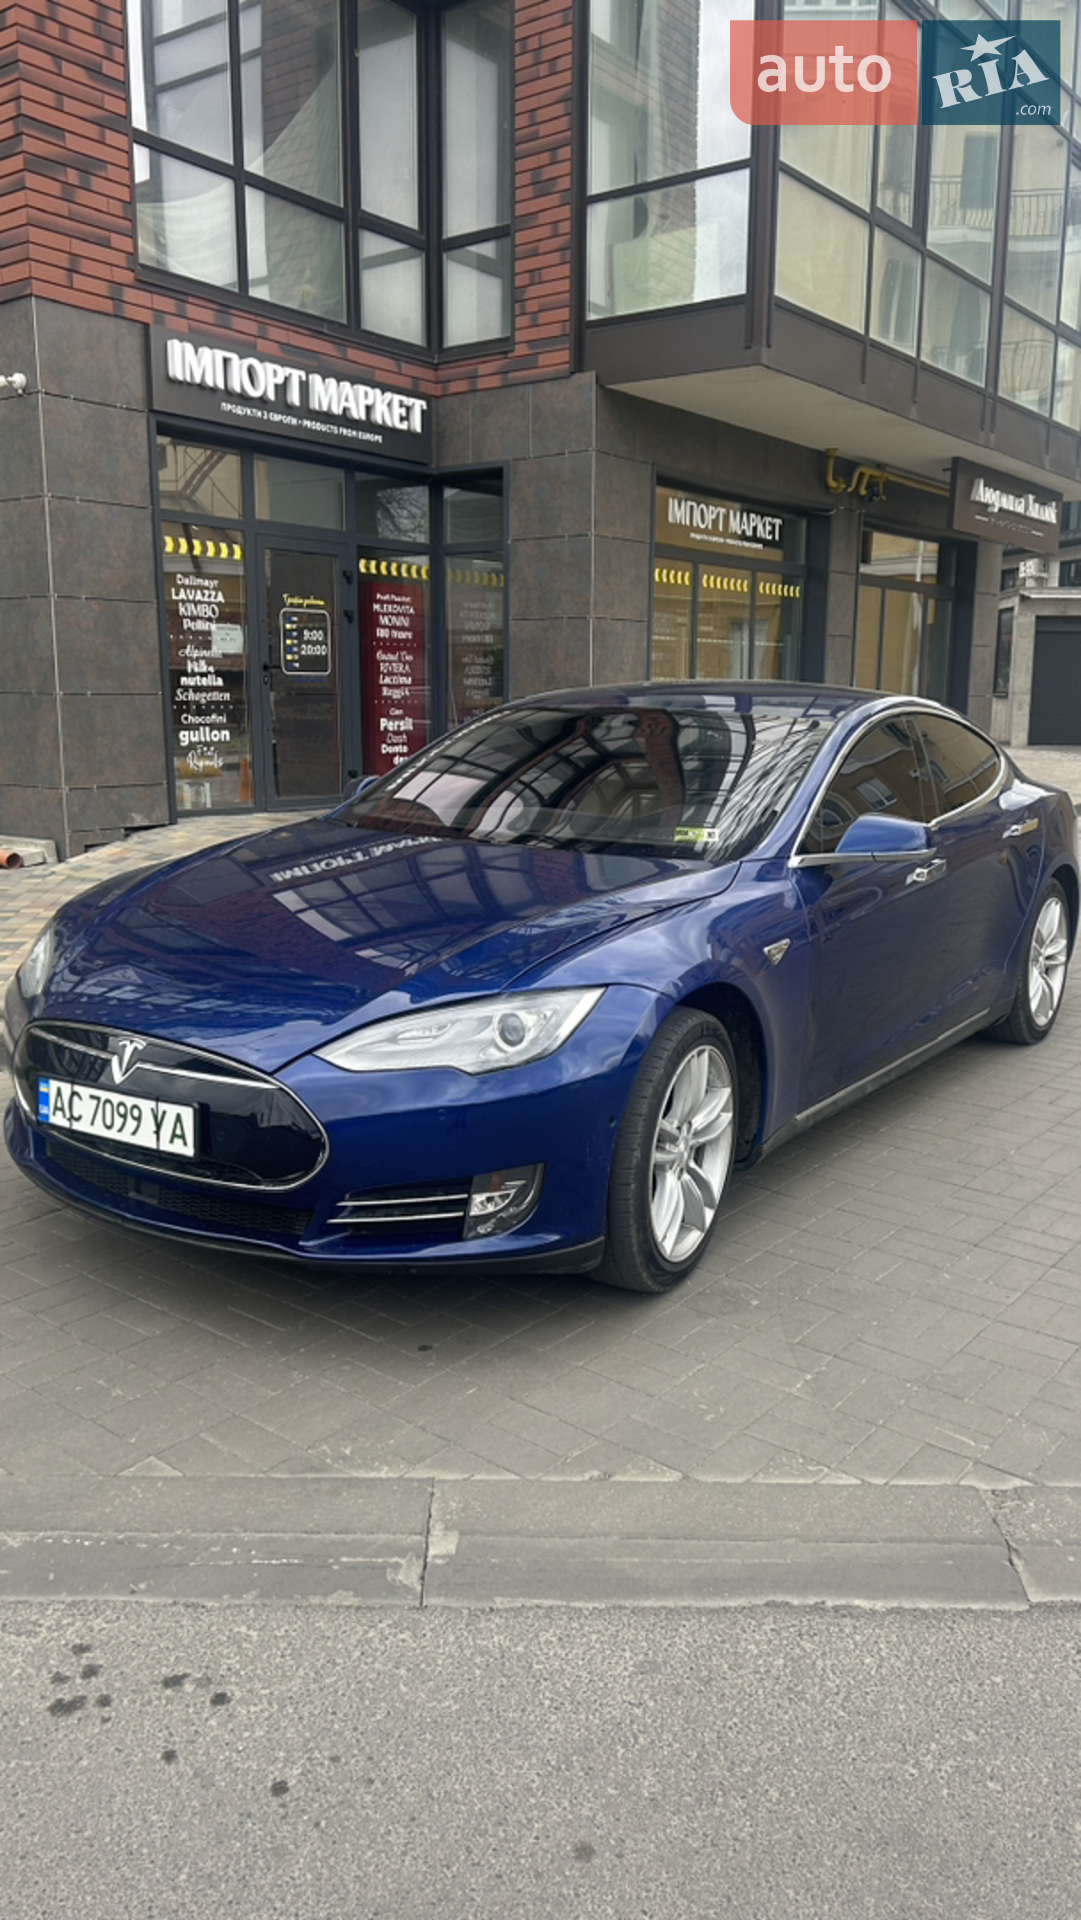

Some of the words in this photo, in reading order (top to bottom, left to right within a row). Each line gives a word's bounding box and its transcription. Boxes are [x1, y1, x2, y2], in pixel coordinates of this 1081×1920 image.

[166, 338, 307, 406] ІМПОРТ
[309, 373, 427, 433] МАРКЕТ
[668, 497, 727, 532] ІМПОРТ
[728, 509, 783, 541] МАРКЕТ
[176, 573, 219, 589] Dallmayr
[171, 587, 225, 604] LAVAZZA
[178, 602, 219, 618] KIMBO
[303, 629, 324, 641] 9:00
[300, 645, 327, 656] 20:00
[180, 674, 224, 687] nutella
[181, 713, 227, 725] Chocofini
[380, 717, 413, 731] Persil
[52, 1086, 83, 1122] AC
[89, 1095, 143, 1136] 7099
[150, 1107, 188, 1147] YA
